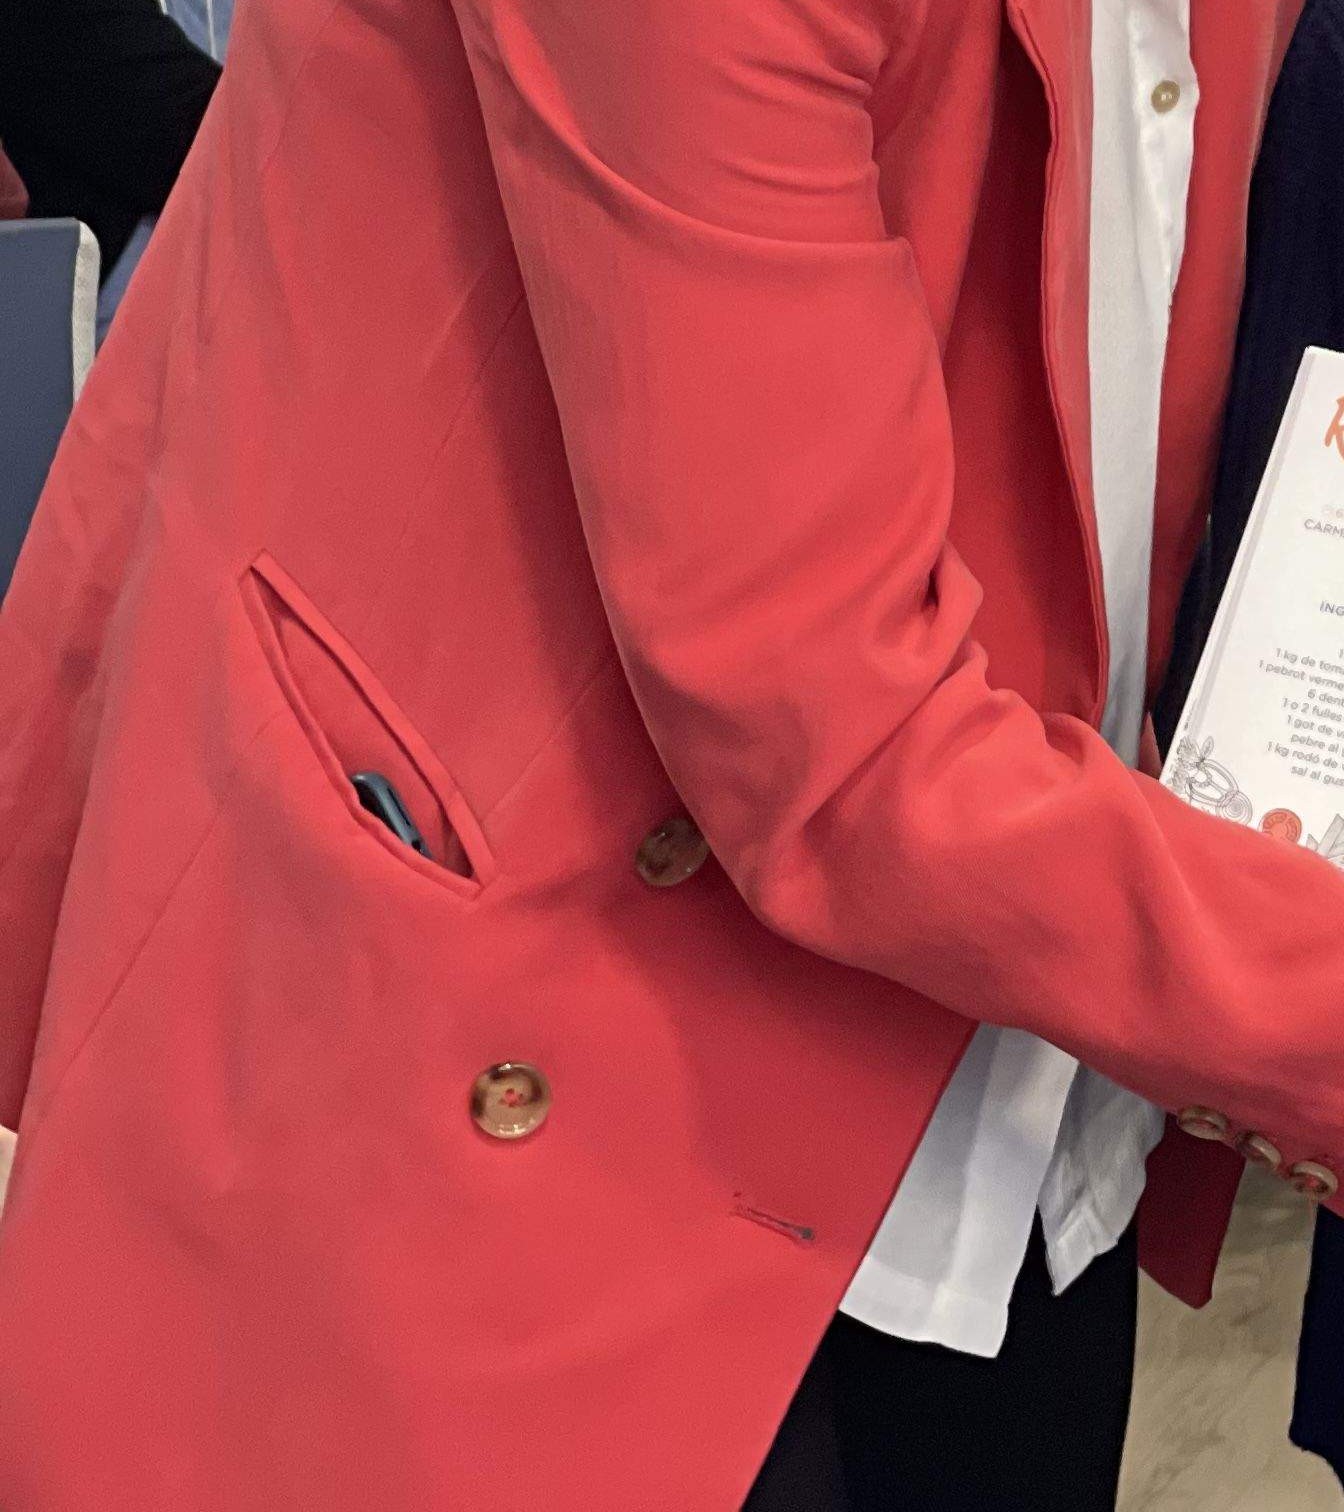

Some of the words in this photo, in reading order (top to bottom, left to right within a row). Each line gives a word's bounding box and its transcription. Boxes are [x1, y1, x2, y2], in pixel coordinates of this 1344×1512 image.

[1282, 648, 1299, 663] kg
[1300, 653, 1317, 666] de
[1264, 658, 1307, 681] pebrot
[1311, 704, 1343, 722] fulles
[1293, 715, 1316, 732] got
[1317, 722, 1334, 735] de
[1289, 730, 1327, 752] pebre
[1327, 741, 1340, 753] al
[1273, 741, 1291, 757] kg
[1291, 747, 1321, 764] rodó
[1322, 755, 1339, 769] de
[1290, 762, 1308, 776] sal
[1309, 768, 1322, 780] al
